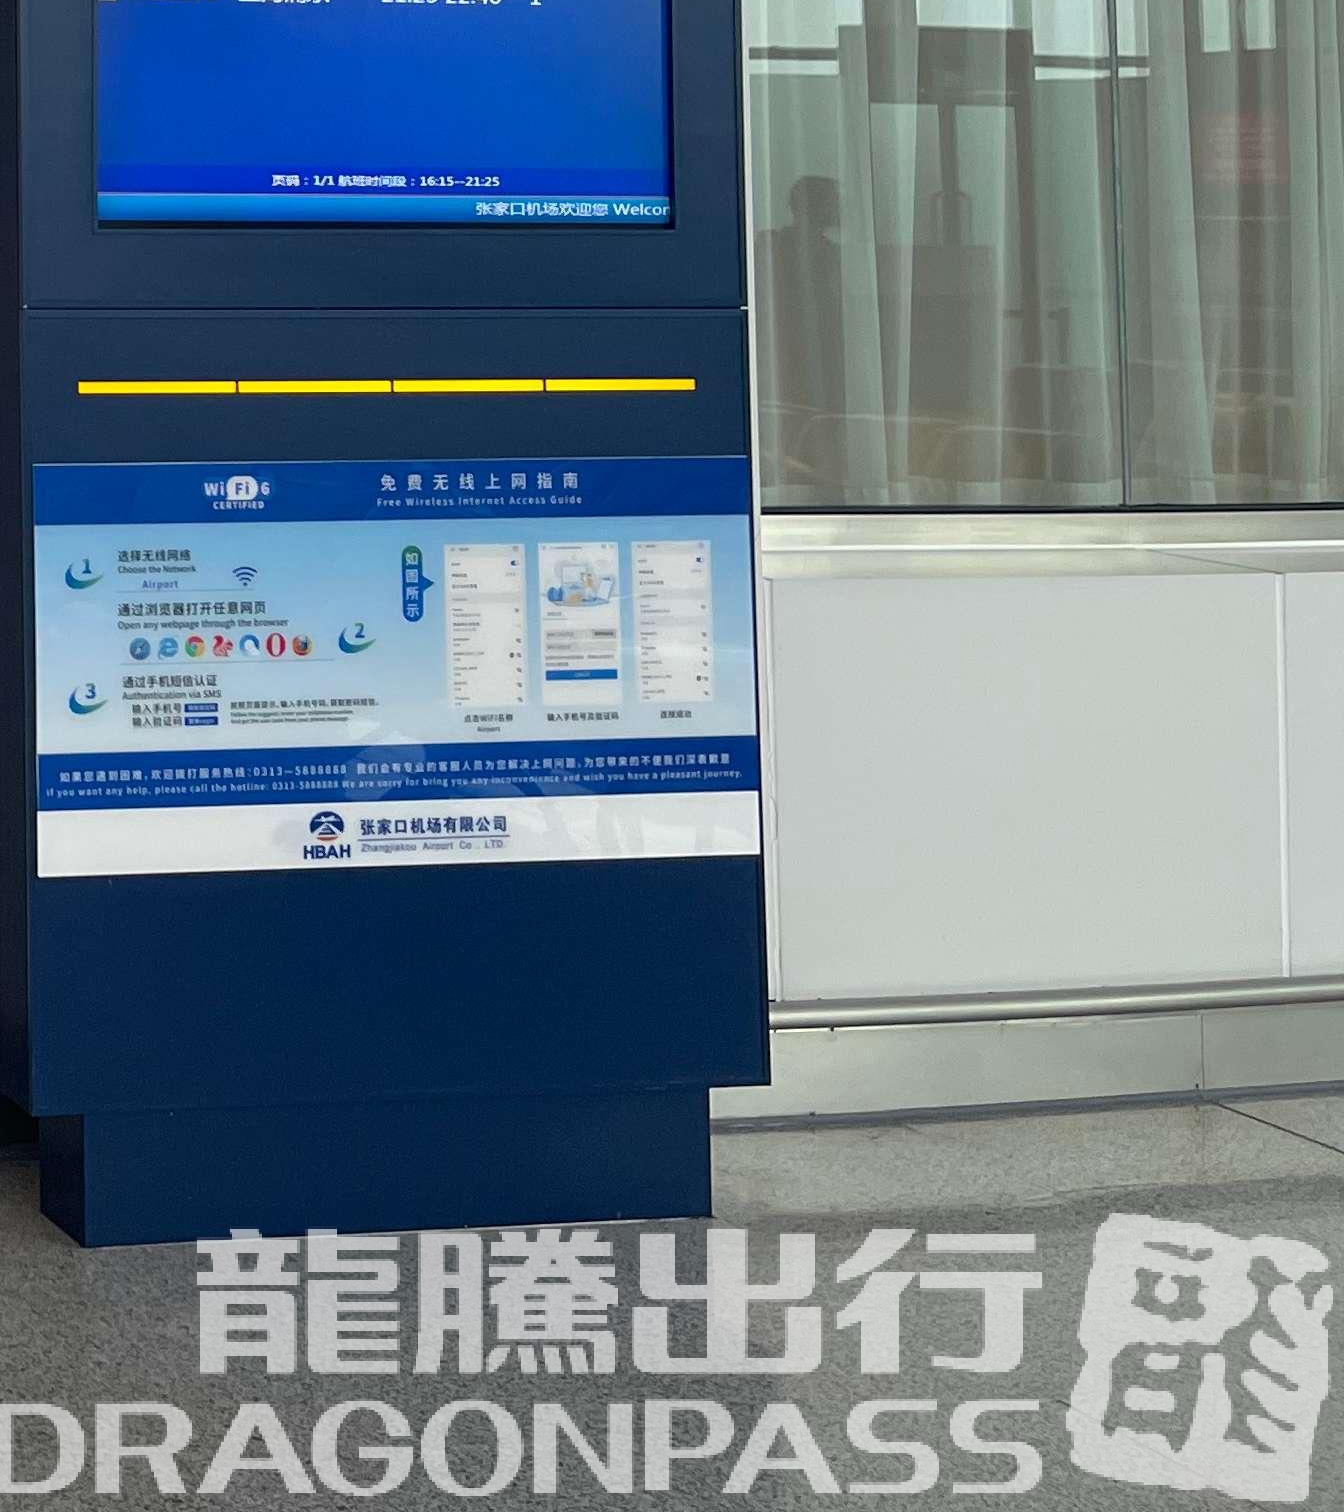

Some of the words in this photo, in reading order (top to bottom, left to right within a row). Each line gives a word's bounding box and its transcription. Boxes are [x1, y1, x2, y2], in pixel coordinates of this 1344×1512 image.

[475, 201, 609, 217] 张家口机场欢迎您
[260, 481, 271, 496] 6
[380, 472, 580, 491] 免费无线上网指南
[212, 500, 265, 510] CERTIFIED
[377, 497, 401, 507] Free
[405, 497, 454, 507] Wireless
[458, 496, 505, 506] Internet
[509, 495, 546, 505] Access
[550, 494, 582, 504] Guide
[118, 549, 191, 562] 选择无线网络
[81, 559, 92, 574] 1
[118, 565, 147, 574] Choose
[148, 565, 162, 574] the
[162, 564, 196, 574] Network
[142, 579, 179, 590] Airport
[117, 600, 266, 617] 通过浏览器打开任意网页
[117, 621, 141, 631] Open
[143, 620, 158, 630] any
[160, 619, 200, 630] webpage
[201, 618, 236, 629] through
[238, 618, 252, 627] the
[254, 617, 288, 627] browser
[354, 623, 365, 638] 2
[122, 674, 218, 689] 通过手机短信认证
[85, 683, 96, 699] 3
[122, 690, 187, 700] Authentication
[188, 689, 202, 699] via
[203, 688, 222, 698] SMS
[56, 788, 75, 798] you
[79, 787, 103, 797] want
[105, 787, 123, 798] any
[155, 785, 187, 796] please
[190, 783, 208, 793] call
[211, 783, 226, 792] the
[359, 780, 373, 789] are
[378, 778, 402, 789] sorry
[405, 777, 419, 786] for
[423, 776, 448, 787] bring
[451, 777, 468, 786] you
[471, 776, 489, 786] any
[563, 771, 580, 782] and
[583, 771, 605, 782] wish
[607, 772, 624, 782] you
[627, 771, 650, 781] have
[660, 770, 701, 781] pleasant
[360, 815, 507, 836] 张家口机场有限公司
[303, 844, 351, 860] HBAH
[361, 842, 417, 854] Zhangjiakou
[422, 840, 454, 851] Airport
